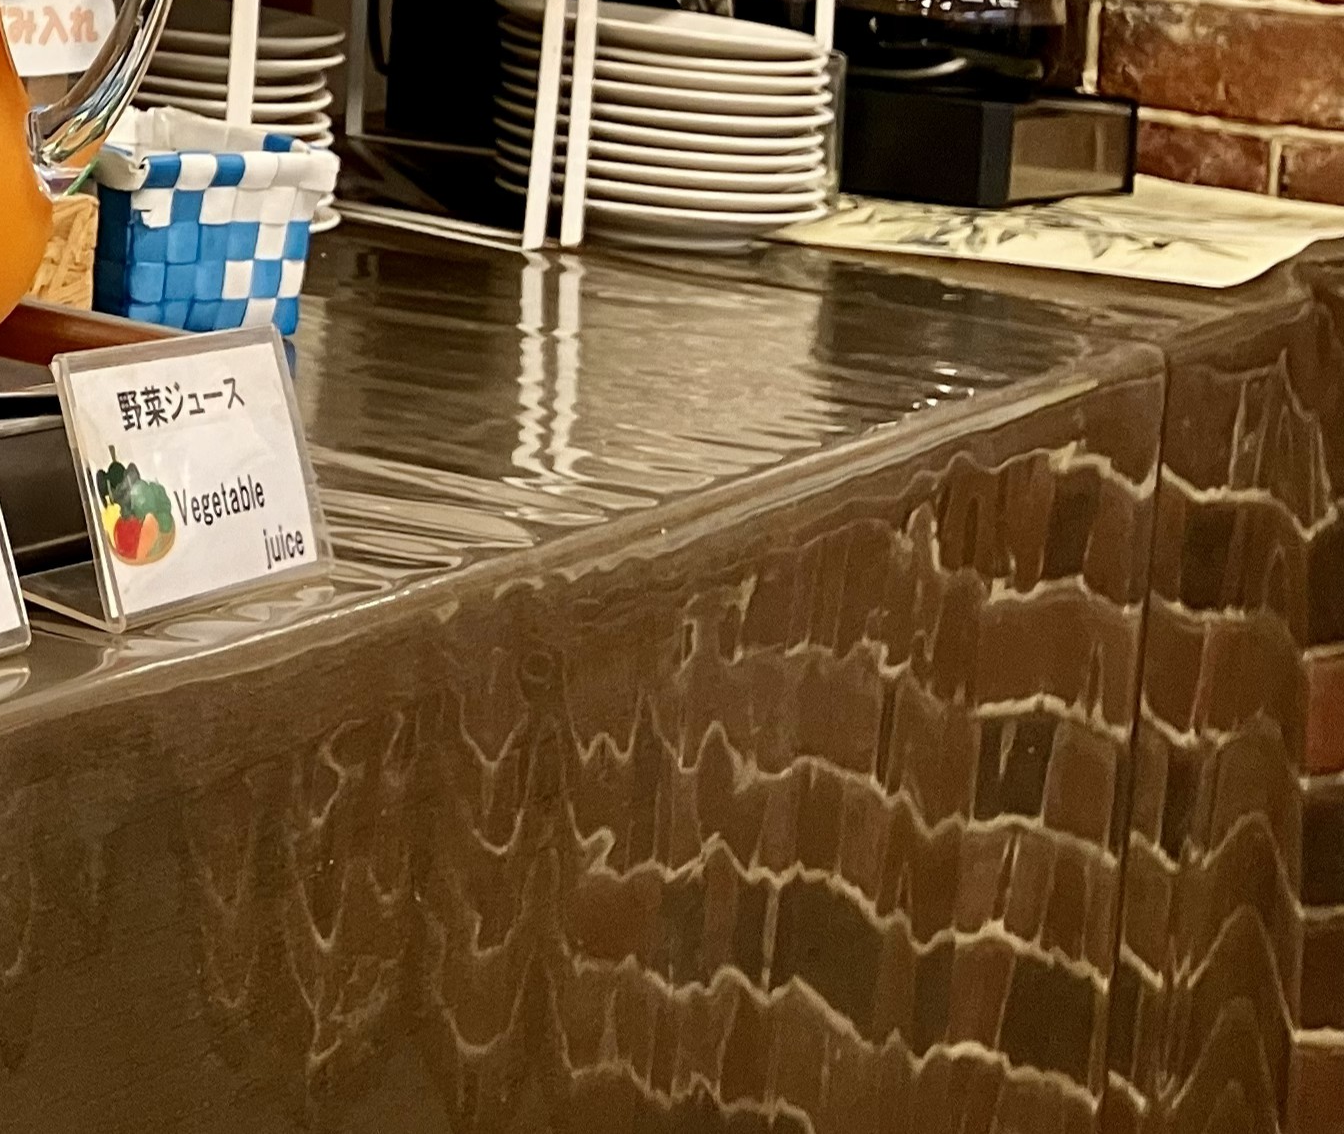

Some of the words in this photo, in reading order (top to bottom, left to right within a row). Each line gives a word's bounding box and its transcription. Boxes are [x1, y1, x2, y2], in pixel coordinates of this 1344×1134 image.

[0, 5, 99, 46] み入れ
[116, 376, 245, 432] 野菜ジュース
[173, 475, 265, 527] Vegetable
[262, 527, 305, 570] juice
